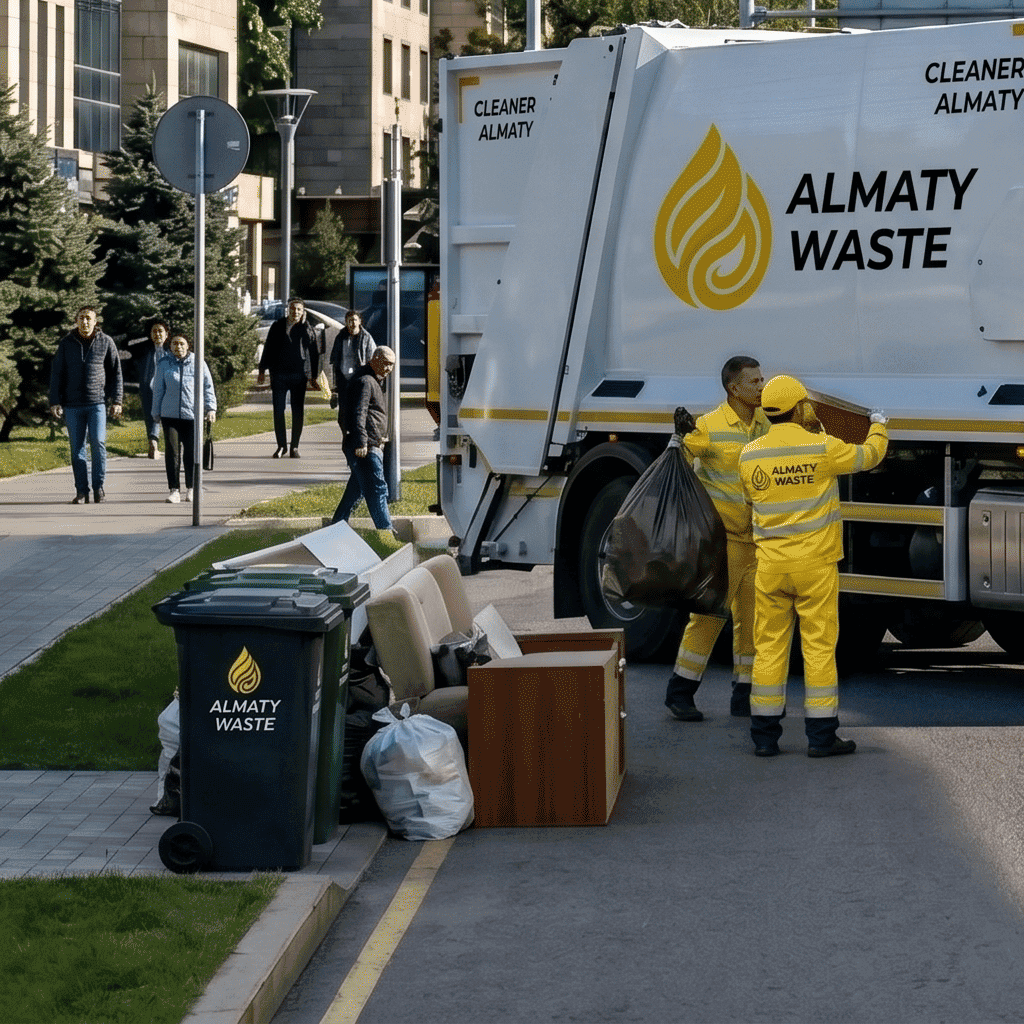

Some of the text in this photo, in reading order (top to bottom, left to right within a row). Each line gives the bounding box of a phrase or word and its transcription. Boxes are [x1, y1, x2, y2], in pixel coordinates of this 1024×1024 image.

[474, 96, 536, 117] CLEANER
[478, 120, 534, 141] ALMATY
[785, 168, 979, 214] ALMATY
[790, 227, 952, 271] WASTE
[771, 463, 818, 475] ALMATY
[774, 475, 815, 486] WASTE
[209, 699, 282, 713] ALMATY
[215, 717, 277, 731] WASTE
